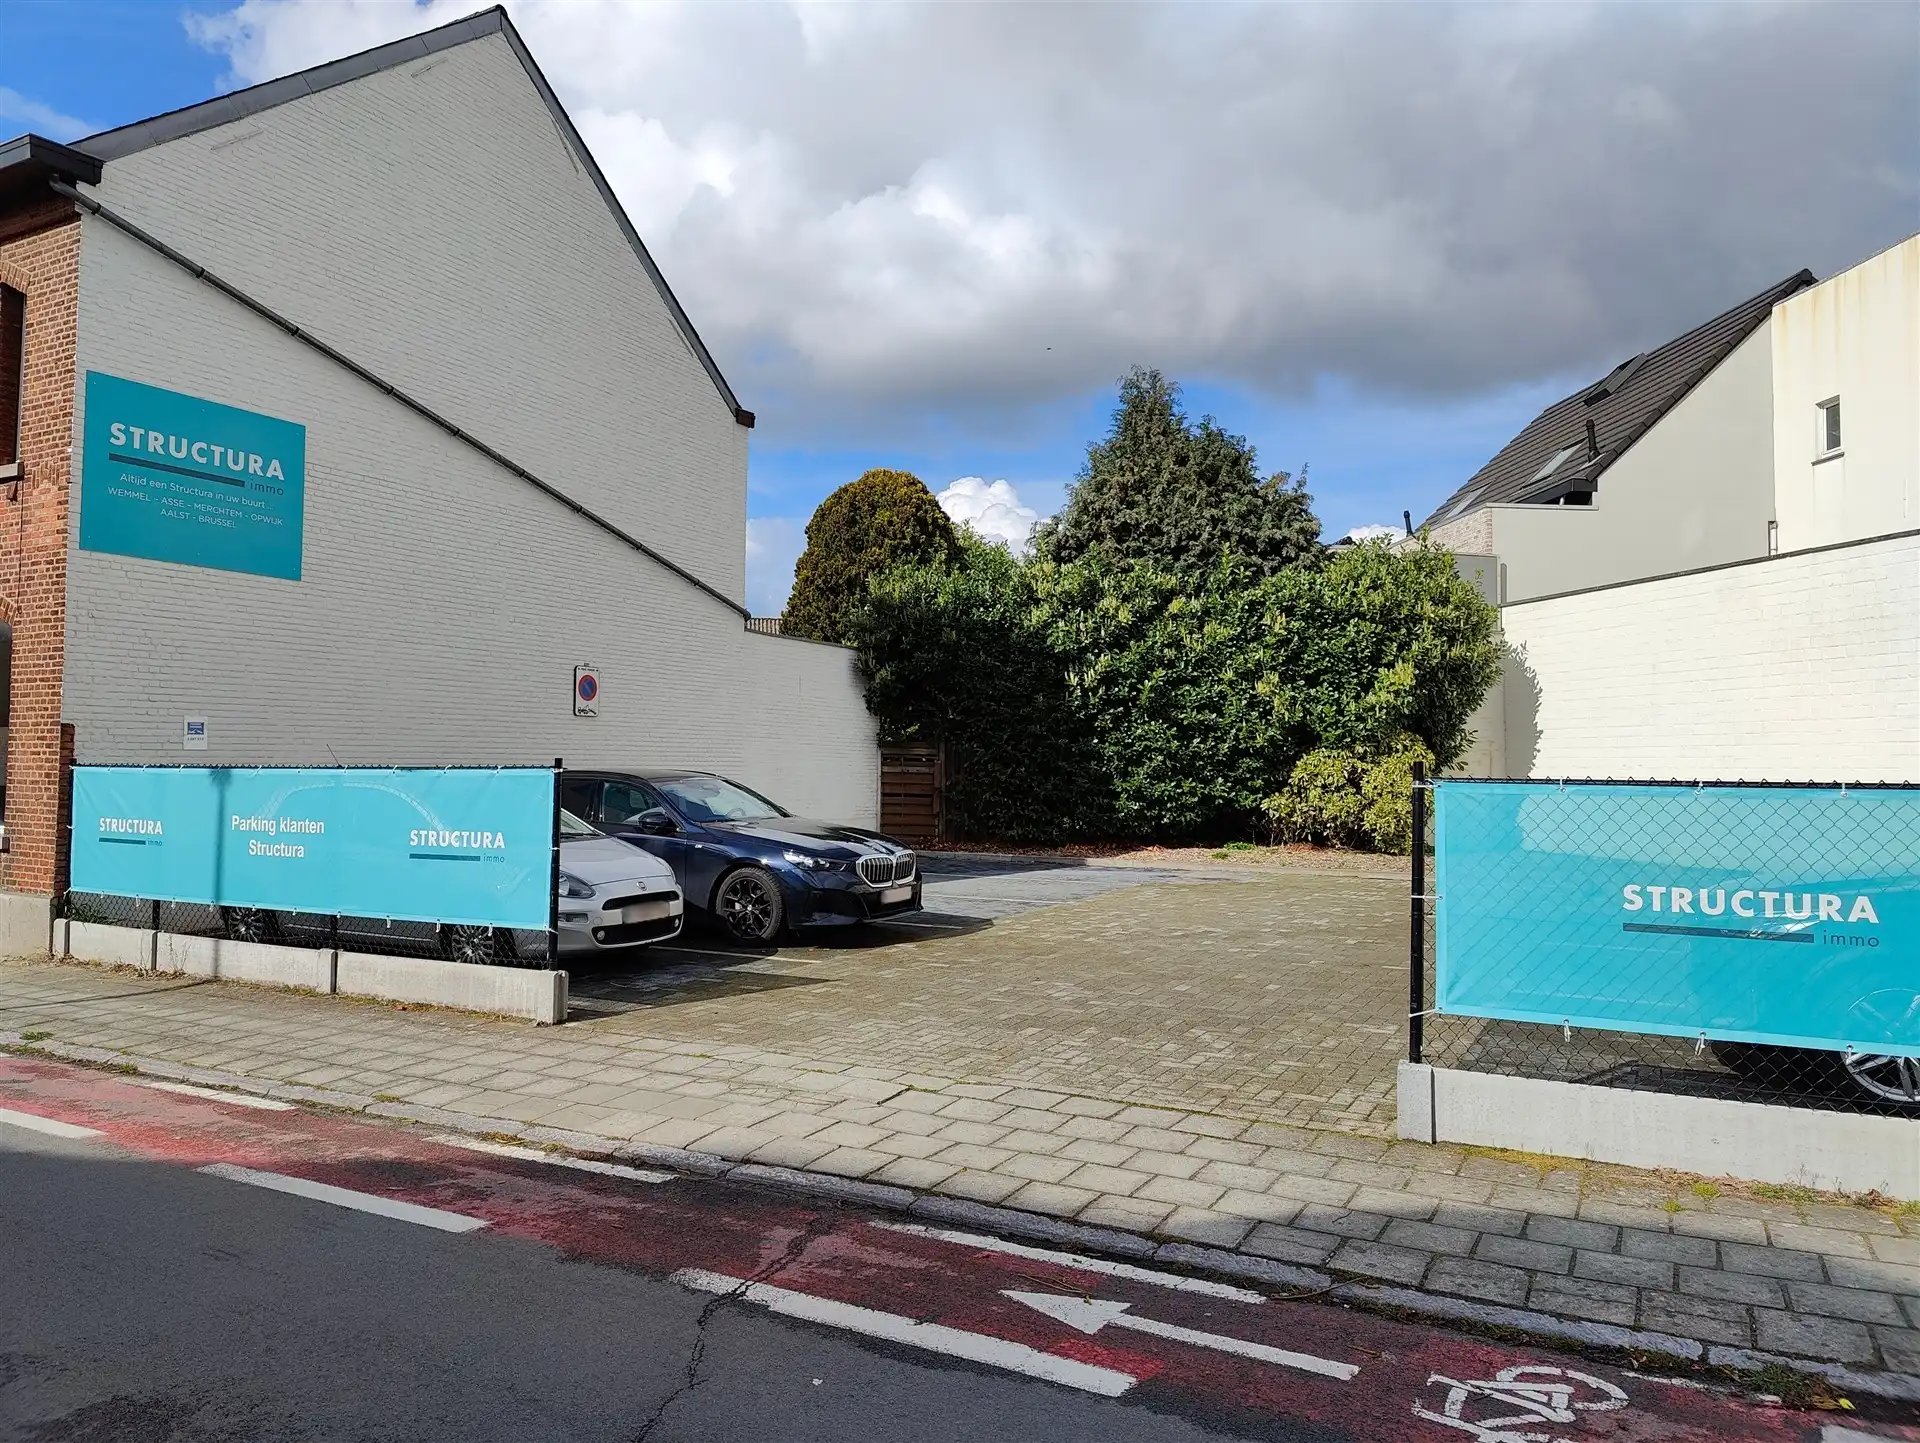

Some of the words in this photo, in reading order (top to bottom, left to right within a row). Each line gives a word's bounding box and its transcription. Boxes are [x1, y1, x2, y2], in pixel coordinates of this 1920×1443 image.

[109, 422, 285, 481] STRUCTURA
[120, 473, 147, 486] Altijd
[149, 480, 167, 489] een
[170, 482, 213, 498] Structura
[215, 492, 224, 501] in
[226, 495, 240, 503] uw
[242, 497, 265, 509] buurt
[250, 479, 284, 496] immo
[107, 486, 151, 502] WEMMEL
[161, 497, 185, 508] ASSE
[193, 503, 243, 518] MERCHTEM
[250, 513, 283, 526] OPWIJK
[160, 508, 190, 520] AALST
[198, 515, 237, 528] BRUSSEL
[99, 817, 163, 835] STRUCTURA
[231, 814, 277, 836] Parking
[280, 816, 325, 834] klanten
[248, 839, 304, 858] Structura
[409, 829, 506, 849] STRUCTURA
[483, 853, 505, 863] immo
[1622, 884, 1880, 924] STRUCTURA
[1823, 929, 1880, 948] immo
